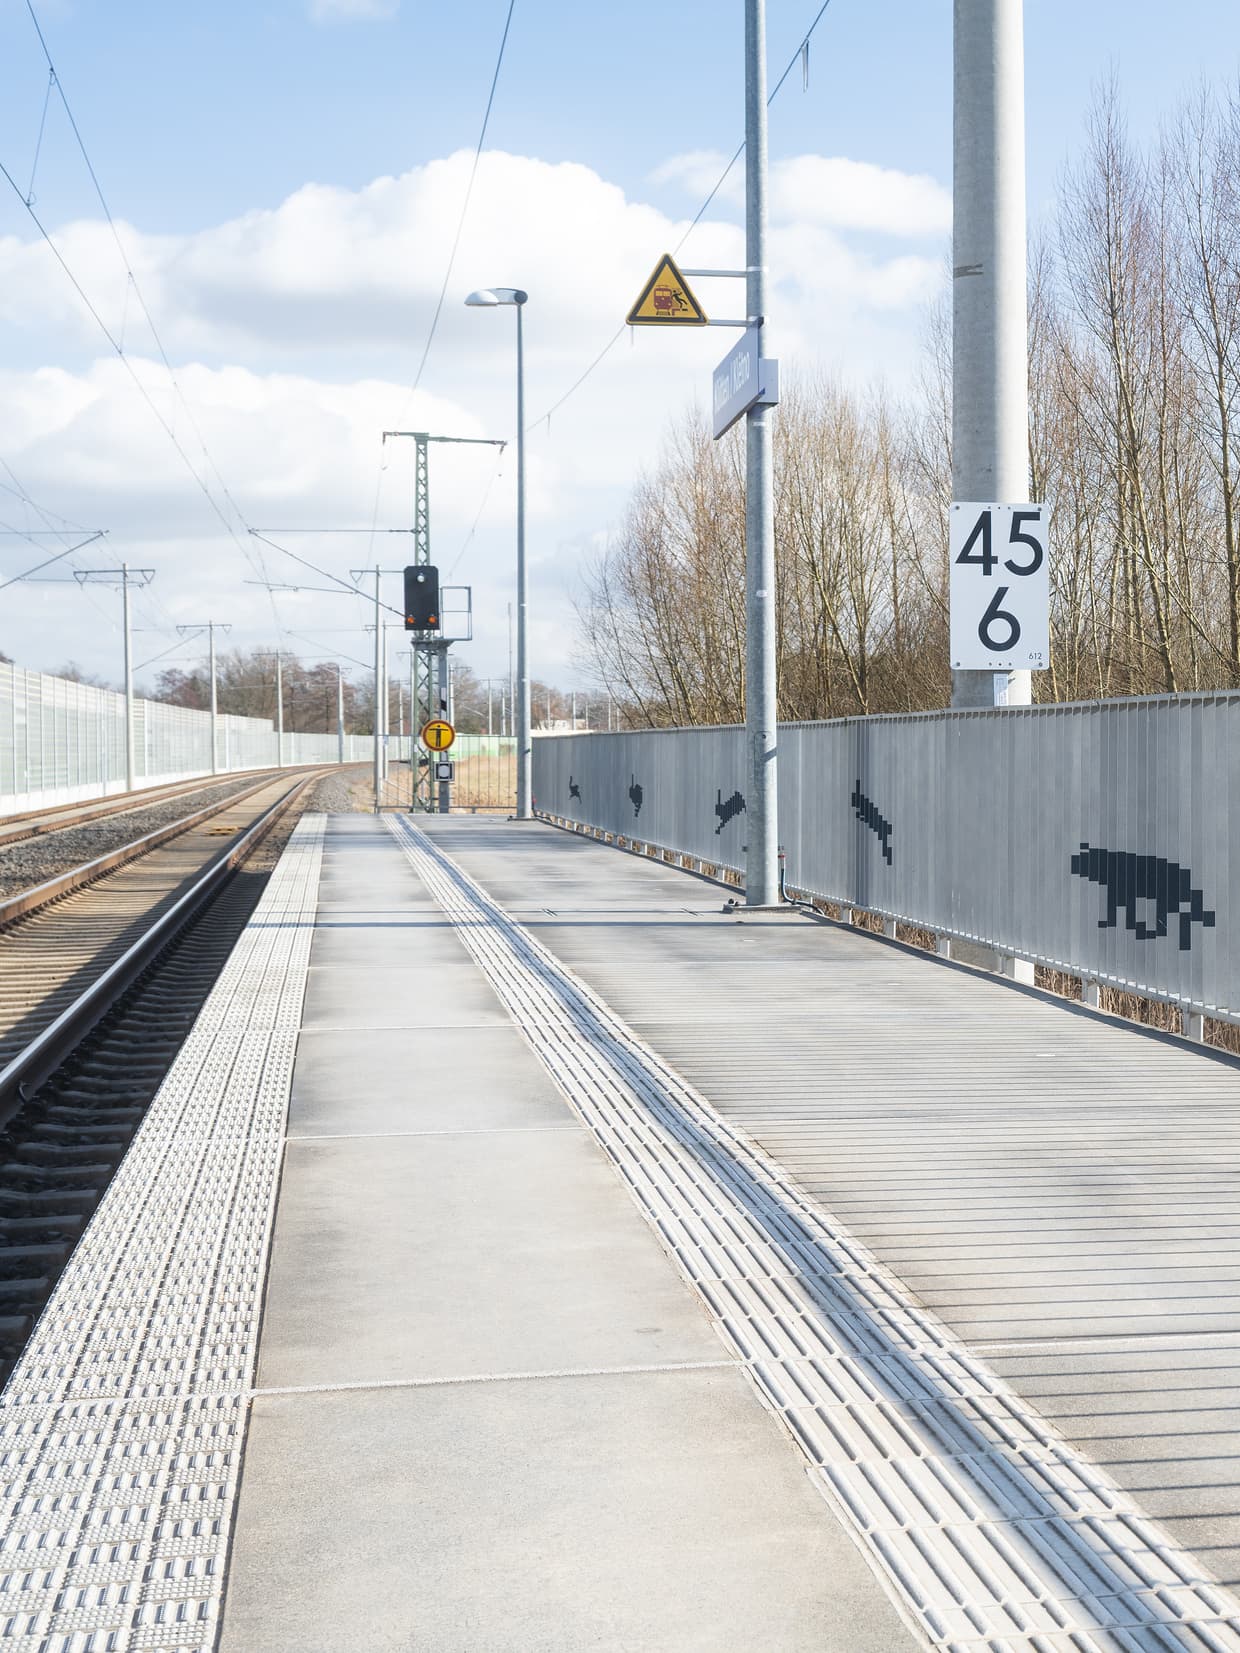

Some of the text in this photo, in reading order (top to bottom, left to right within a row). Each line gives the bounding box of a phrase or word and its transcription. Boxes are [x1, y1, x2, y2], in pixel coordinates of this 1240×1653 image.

[955, 511, 1043, 576] 45
[978, 586, 1021, 652] 6
[1028, 652, 1042, 660] 612
